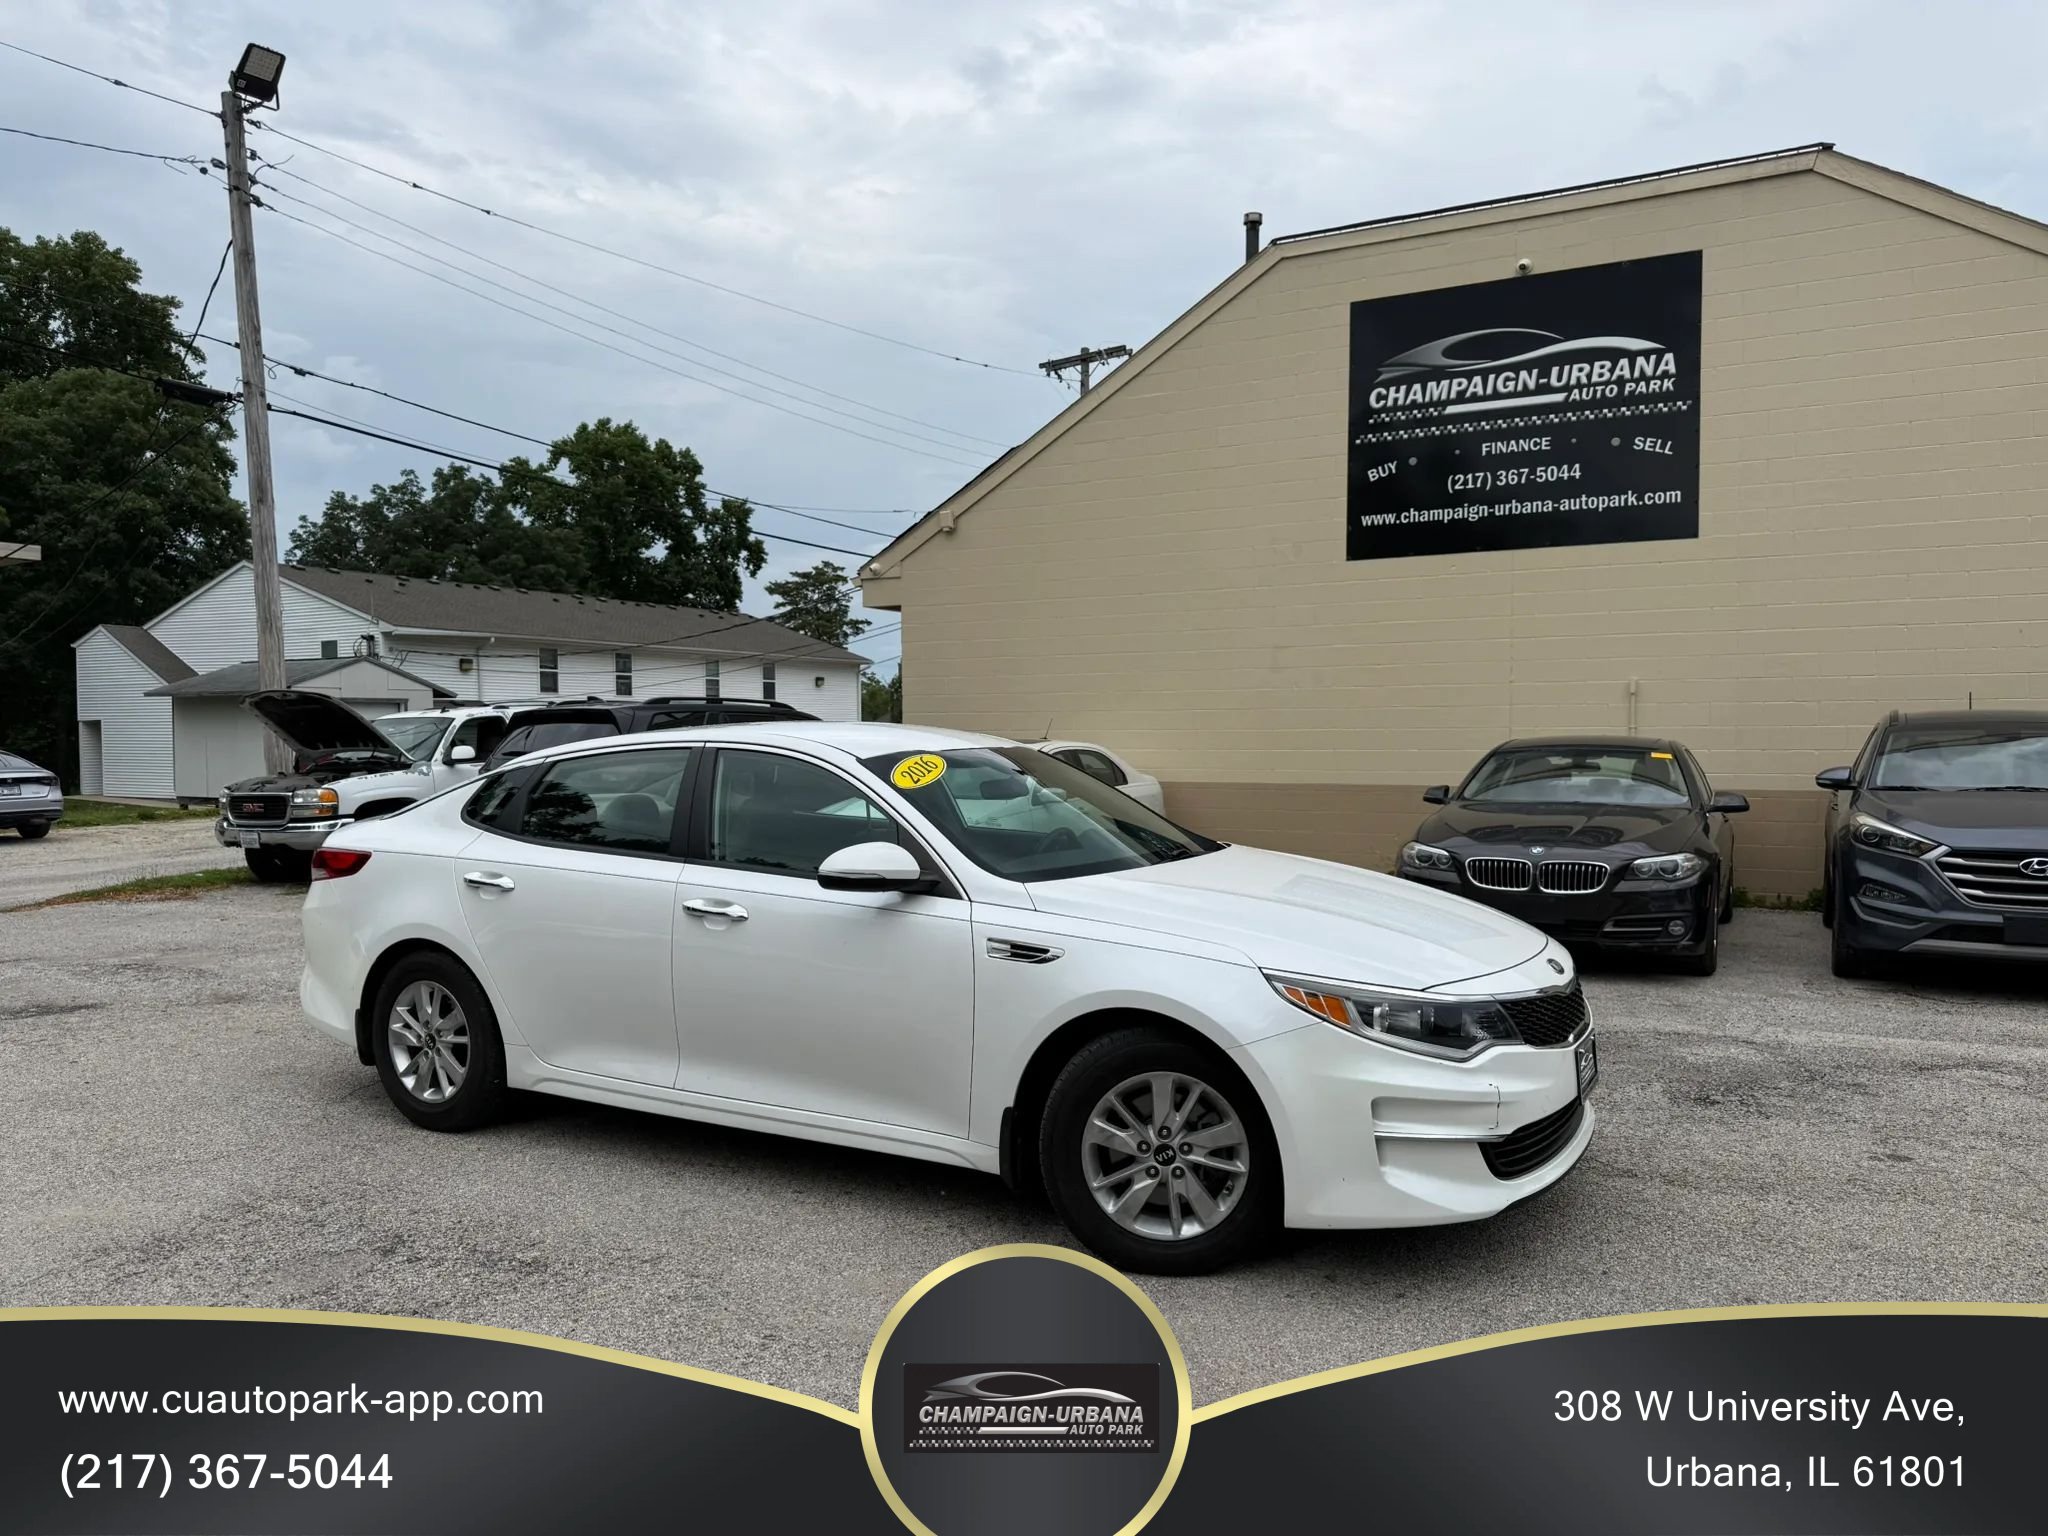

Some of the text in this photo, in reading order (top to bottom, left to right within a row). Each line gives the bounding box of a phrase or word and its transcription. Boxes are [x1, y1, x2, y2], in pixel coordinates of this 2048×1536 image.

[1369, 352, 1677, 409] CHAMPAIGN-URBANA
[1568, 377, 1676, 403] AUTO PARK
[1481, 437, 1552, 456] FINANCE
[1632, 436, 1674, 455] SELL
[1367, 461, 1399, 483] BUY
[1447, 464, 1582, 494] (217) 367-5044
[1361, 490, 1682, 527] www.champaign-urbana-autopark.com
[901, 756, 938, 785] 2016
[242, 803, 265, 813] GMC
